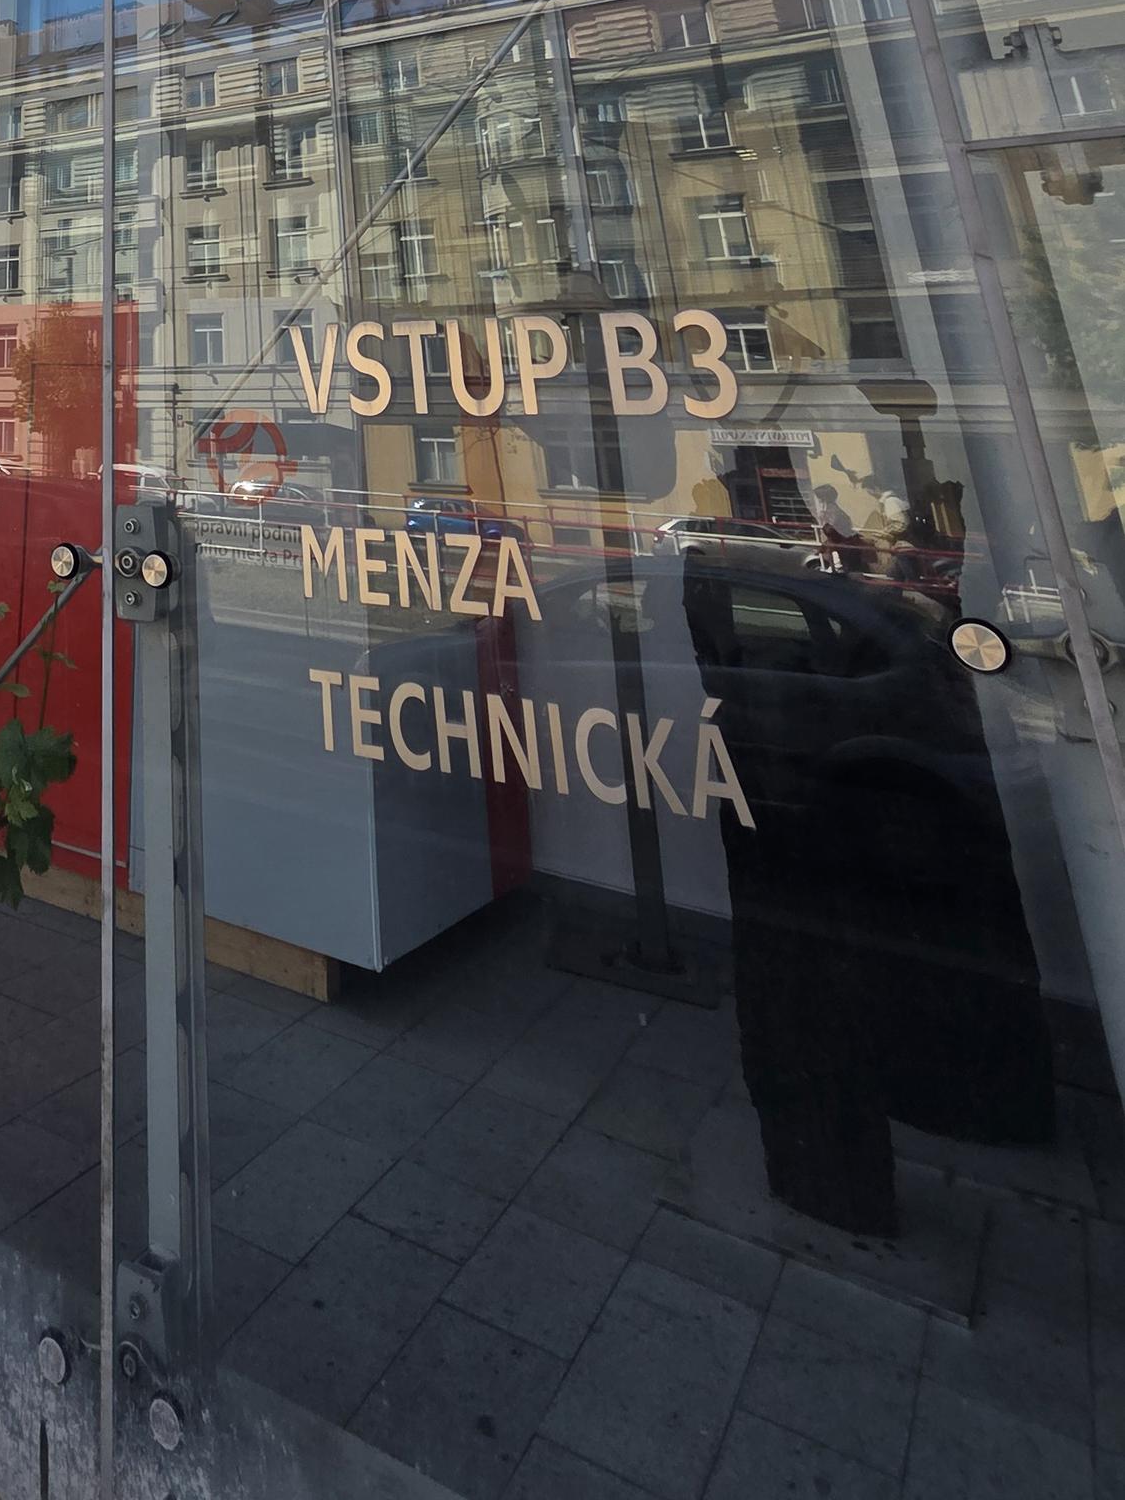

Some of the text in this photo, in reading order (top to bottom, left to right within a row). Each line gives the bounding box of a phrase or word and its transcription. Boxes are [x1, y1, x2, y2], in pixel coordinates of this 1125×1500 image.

[288, 308, 740, 420] VSTUP B3
[191, 521, 302, 542] opravní podni
[300, 524, 543, 621] MENZA
[309, 668, 757, 831] TECHNICKÁ
